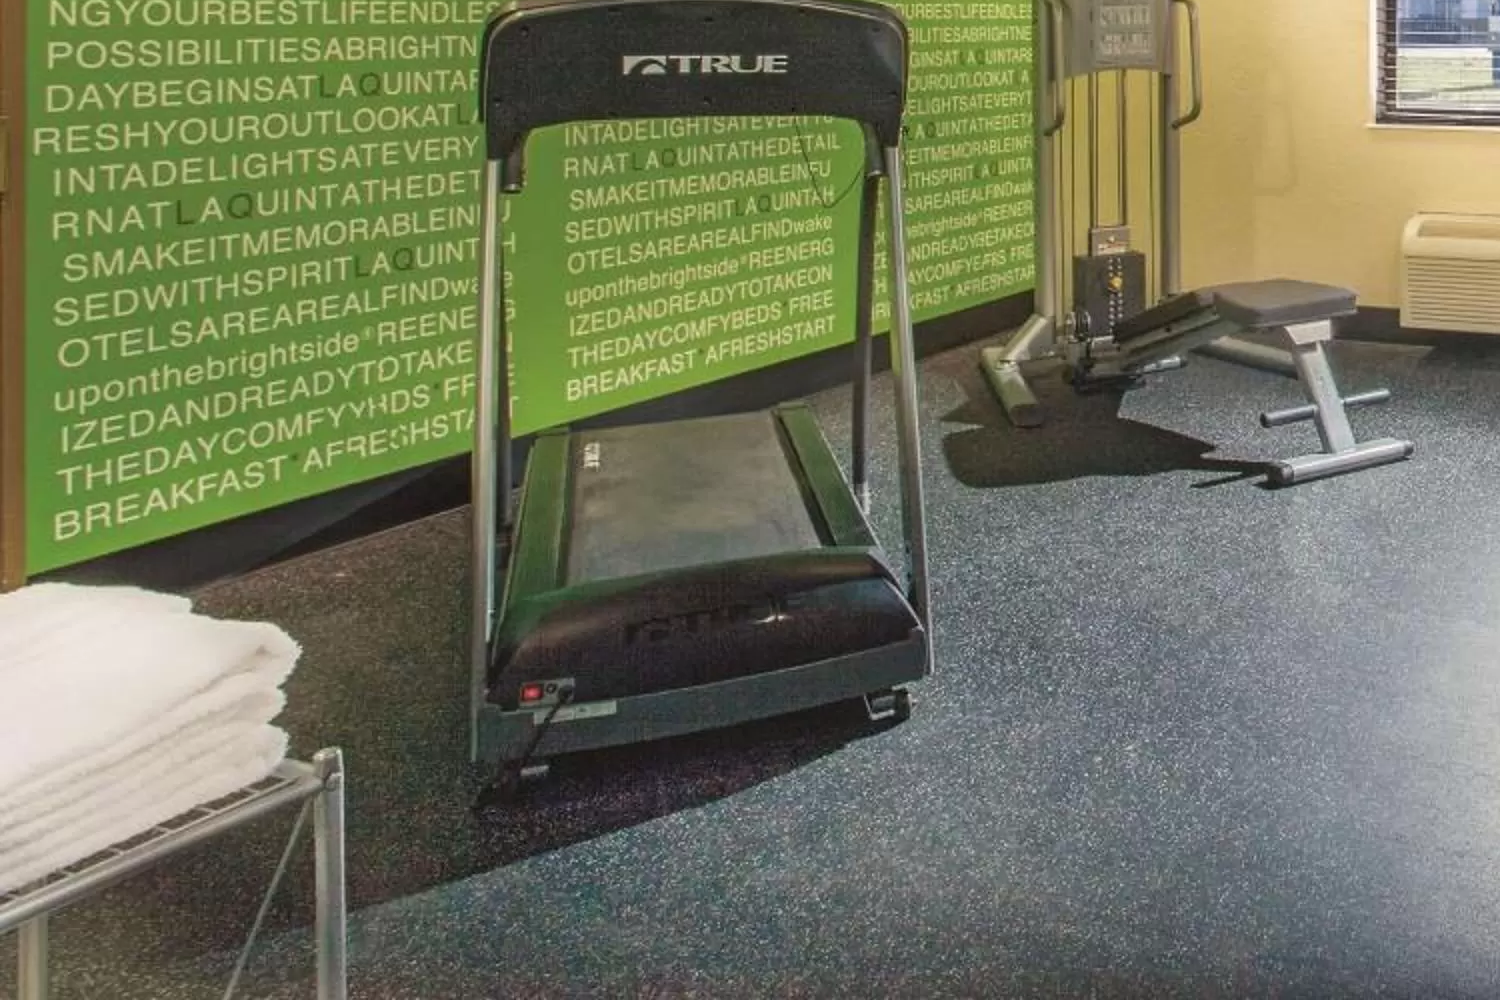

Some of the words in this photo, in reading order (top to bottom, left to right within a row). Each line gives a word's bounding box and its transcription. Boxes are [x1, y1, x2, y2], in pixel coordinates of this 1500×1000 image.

[49, 0, 500, 26] NGYOURBESTLIFEENDLE
[47, 34, 477, 69] POSSIBILITIESABRIGHTN
[667, 55, 788, 74] TRUE
[53, 136, 479, 196] INTADELIGHTSATEVERY
[569, 160, 830, 211] SMAKEITMEMORABLEINFU
[52, 169, 480, 240] RNATLAQUINTATHEDET
[568, 302, 781, 368] THEDAYCOMFYBEDS
[789, 290, 833, 317] FREE
[569, 264, 833, 337] IZEDANDREADYTOTAKEON
[567, 349, 698, 402] BREAKFAST
[705, 316, 836, 365] AFRESHSTART
[54, 457, 288, 541] BREAKFAST
